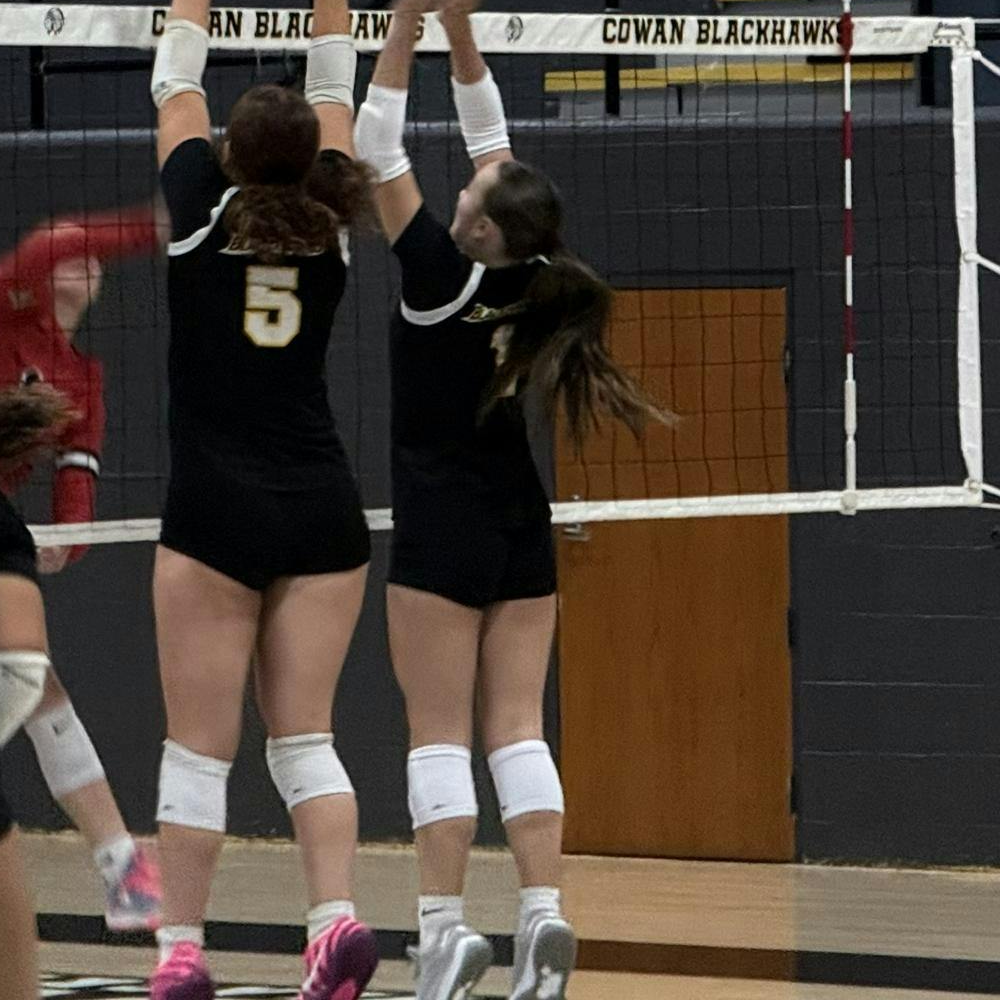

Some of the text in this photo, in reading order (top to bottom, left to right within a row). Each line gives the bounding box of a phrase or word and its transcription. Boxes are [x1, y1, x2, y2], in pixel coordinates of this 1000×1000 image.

[152, 9, 243, 38] CAN
[602, 17, 686, 45] COWAN
[243, 265, 303, 348] 5
